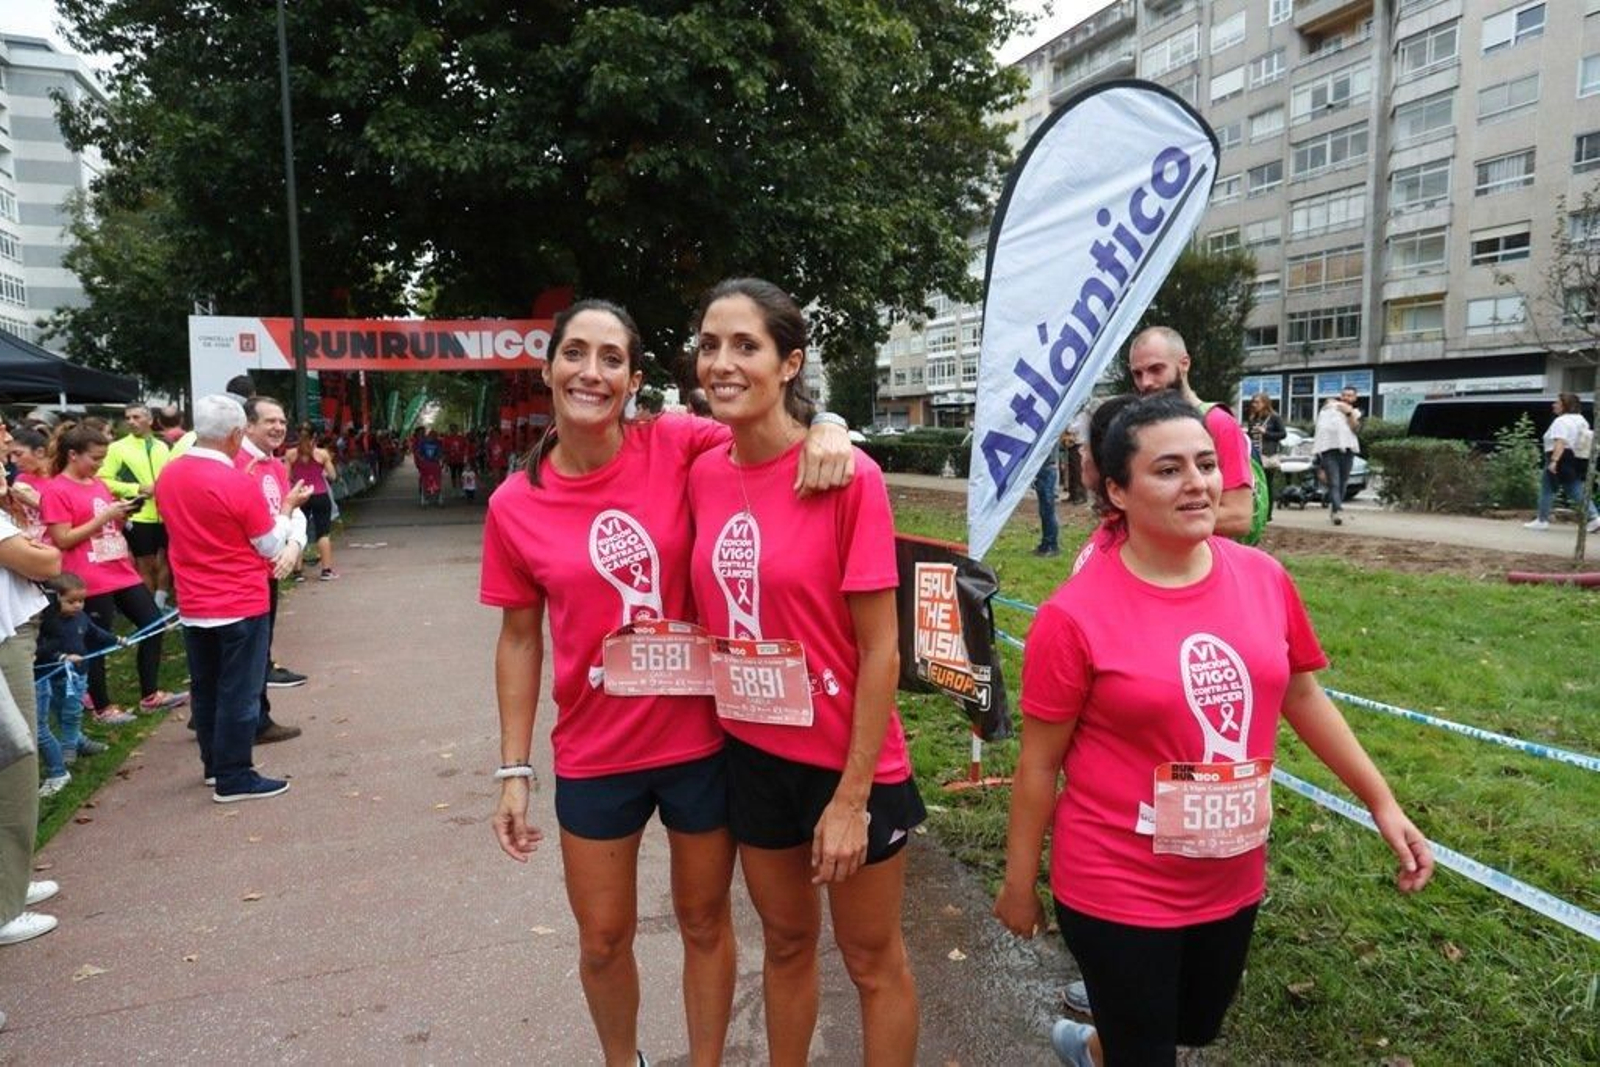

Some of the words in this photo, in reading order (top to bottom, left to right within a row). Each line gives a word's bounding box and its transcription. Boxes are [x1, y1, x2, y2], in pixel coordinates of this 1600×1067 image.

[980, 145, 1191, 502] Atlántico
[599, 517, 623, 536] VI
[732, 523, 749, 539] VI
[598, 533, 640, 556] VIGO
[720, 547, 754, 560] VIGO
[919, 600, 953, 632] THE
[631, 643, 691, 671] 5681
[1190, 643, 1217, 661] VI
[729, 665, 785, 699] 5891
[930, 666, 976, 695] EUROP
[1191, 667, 1237, 687] VIGO
[1194, 683, 1230, 695] CONTRA
[1183, 791, 1257, 830] 5853
